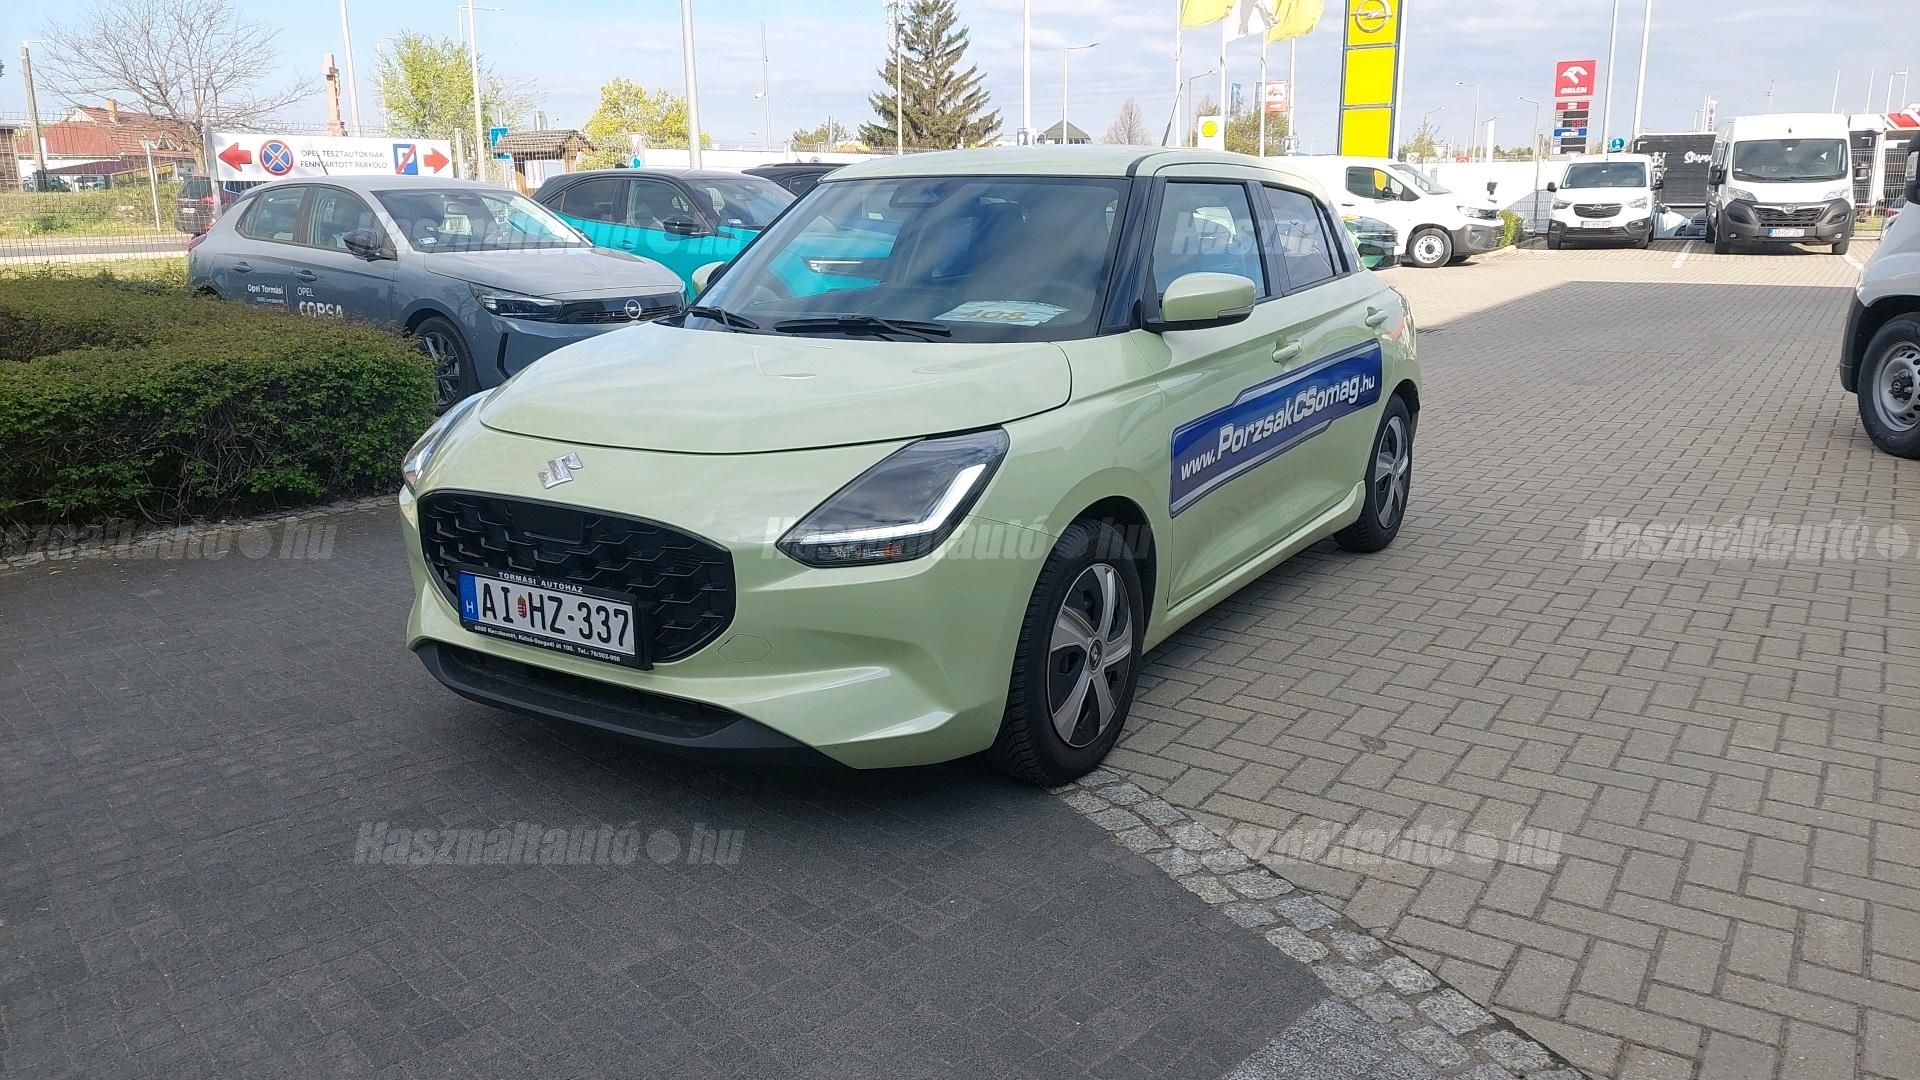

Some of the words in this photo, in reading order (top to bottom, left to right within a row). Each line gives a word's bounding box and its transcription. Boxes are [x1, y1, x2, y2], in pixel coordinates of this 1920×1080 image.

[1560, 86, 1588, 94] ORLEN
[301, 150, 320, 158] OPEL
[247, 283, 261, 294] Opel
[297, 286, 315, 297] OPEL
[482, 582, 514, 624] AI
[528, 591, 629, 648] HZ-337
